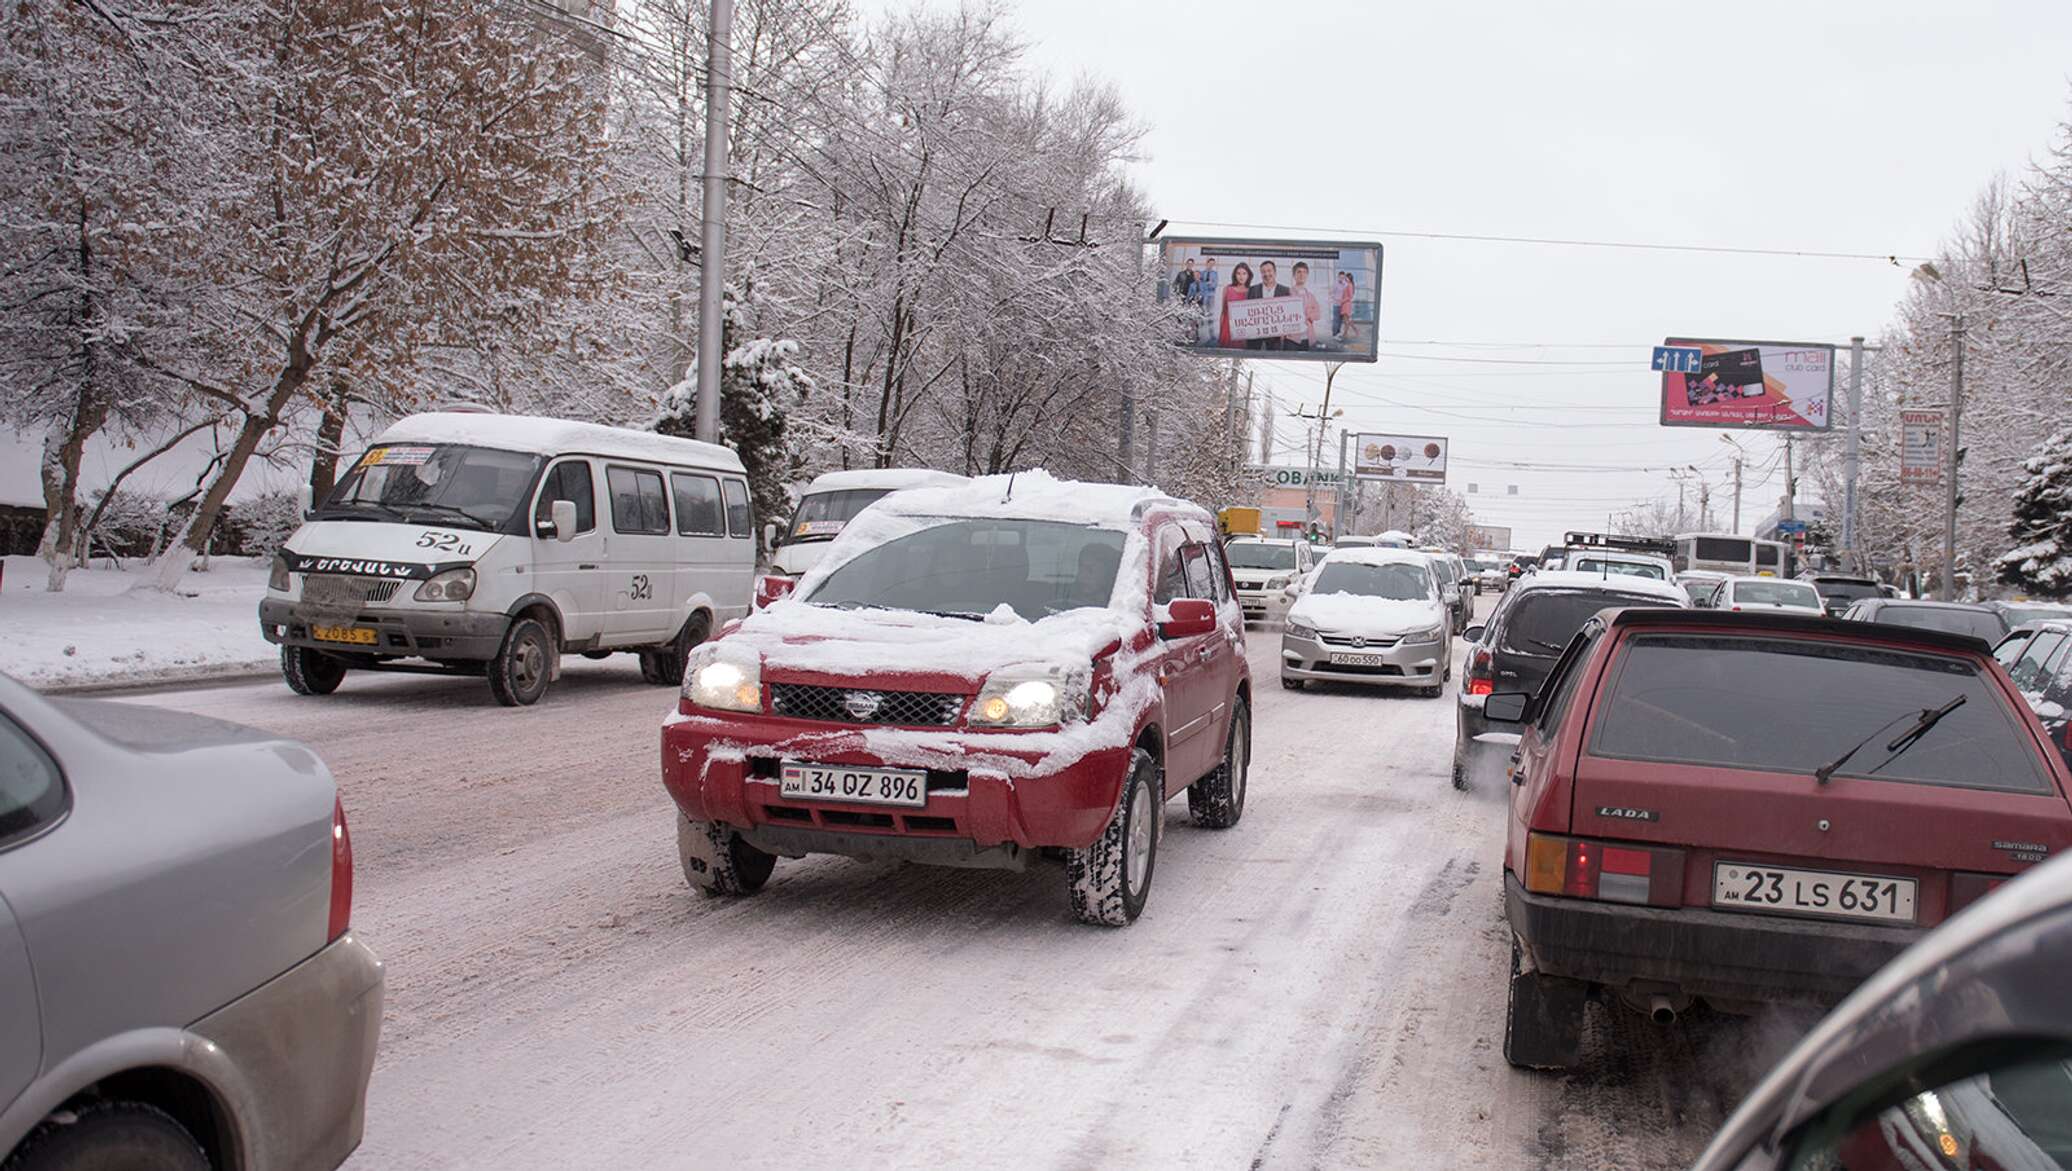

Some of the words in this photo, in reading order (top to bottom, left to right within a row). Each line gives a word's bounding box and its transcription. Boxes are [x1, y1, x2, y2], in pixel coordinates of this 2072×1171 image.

[784, 782, 800, 792] AM
[811, 771, 835, 794] 34
[843, 773, 872, 798] QZ
[880, 776, 917, 800] 896
[1601, 808, 1649, 819] LADA
[1724, 890, 1739, 900] AM
[1744, 871, 1784, 903] 23
[1795, 881, 1829, 907] LS
[1839, 880, 1897, 914] 631
